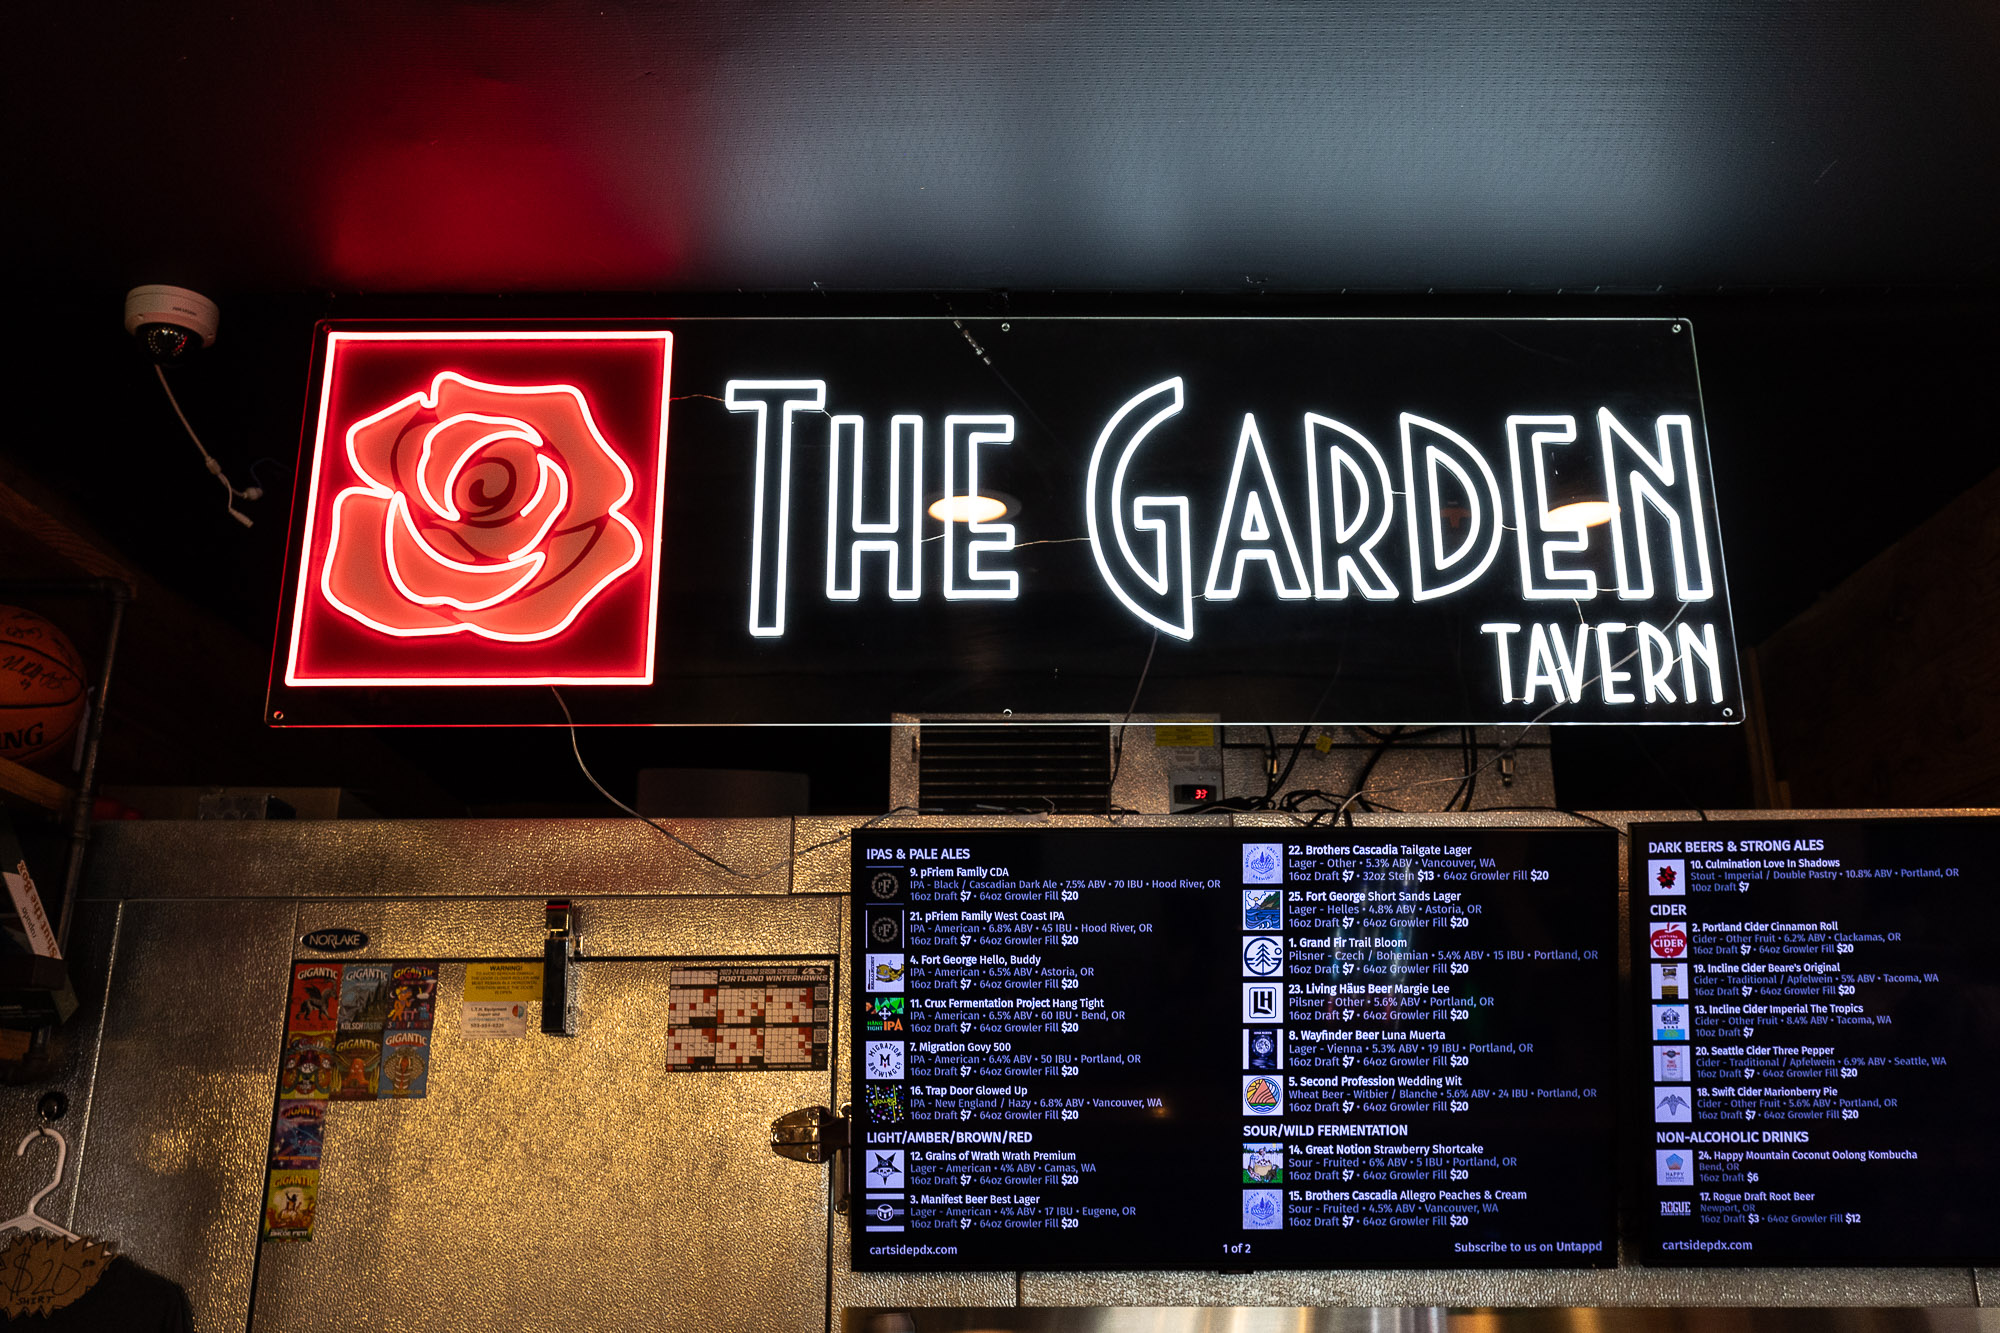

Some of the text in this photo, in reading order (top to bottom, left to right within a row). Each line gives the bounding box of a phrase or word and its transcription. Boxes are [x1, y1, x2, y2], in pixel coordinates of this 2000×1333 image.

[724, 374, 1715, 641] THE GARDEN
[1480, 622, 1726, 705] TAVERN
[1194, 788, 1208, 800] 33
[1287, 844, 1472, 857] 22. Brothers Cascadia Tailgate Lager
[1648, 838, 1825, 854] DARK BEERS & STRONG ALES
[866, 847, 971, 860] IPAS & PALE ALES
[1689, 857, 1841, 870] 10. Culmination Love In Shadows
[18, 863, 33, 893] Box
[909, 866, 1010, 879] 9. pFriem Family CDA
[1288, 869, 1550, 883] 16oz Draft $7 32oz Stein $13 64oz Growler Fill $20
[30, 895, 43, 920] the
[1649, 903, 1687, 916] CIDER
[909, 910, 1065, 923] 21. pFriem Family West Coast IPA
[39, 921, 57, 957] Shut
[309, 934, 361, 949] NORLAKE
[1653, 938, 1684, 948] CIDER
[909, 953, 1042, 967] 4. Fort George Hello, Buddy
[297, 966, 338, 981] GIGANTIC
[345, 968, 389, 982] GIGANTIC
[393, 966, 436, 979] GIGANTIC
[910, 967, 926, 977] IPA
[934, 966, 980, 977] American
[988, 966, 1012, 977] 6.5%
[1013, 966, 1033, 977] ABV
[1040, 966, 1078, 978] Astoria,
[1079, 966, 1094, 977] OR
[1692, 961, 1841, 975] 19. Incline Cider Beare's Original
[719, 974, 828, 983] PORTLAND WINTERHAWKS
[1288, 982, 1450, 996] 23. Living Häus Beer Margie Lee
[909, 997, 1105, 1010] 11. Crux Fermentation Project Hang Tight
[1694, 1002, 1864, 1016] 13. Incline Cider Imperial The Tropics
[883, 1018, 903, 1031] IPA
[336, 1039, 381, 1053] GIGANTIC
[385, 1032, 428, 1046] GIGANTIC
[868, 1042, 902, 1057] MIGRATION
[909, 1084, 1028, 1097] 16. Trap Door Glowed Up
[866, 1130, 1033, 1145] LIGHT/AMBER/BROWN/RED
[1242, 1123, 1408, 1138] SOUR/WILD FERMENTATION
[1656, 1130, 1809, 1143] NON-ALCOHOLIC DRINKS
[1697, 1149, 1918, 1162] 24. Happy Mountain Coconut Oolong Kombucha
[274, 1175, 315, 1187] GIGANTIC
[1288, 1188, 1527, 1202] 15. Brothers Cascadia Allegro Peaches & Cream
[1698, 1190, 1816, 1203] 17. Rogue Draft Root Beer
[1660, 1201, 1691, 1213] ROGUE
[869, 1243, 958, 1257] cartsidepdx.com
[1223, 1242, 1251, 1254] 1 of 2
[1454, 1240, 1603, 1254] Subscribe to us on Untappd
[1661, 1239, 1753, 1252] cartsidepdx.com
[4, 1247, 82, 1301] $20
[16, 1295, 55, 1306] SHIRT
